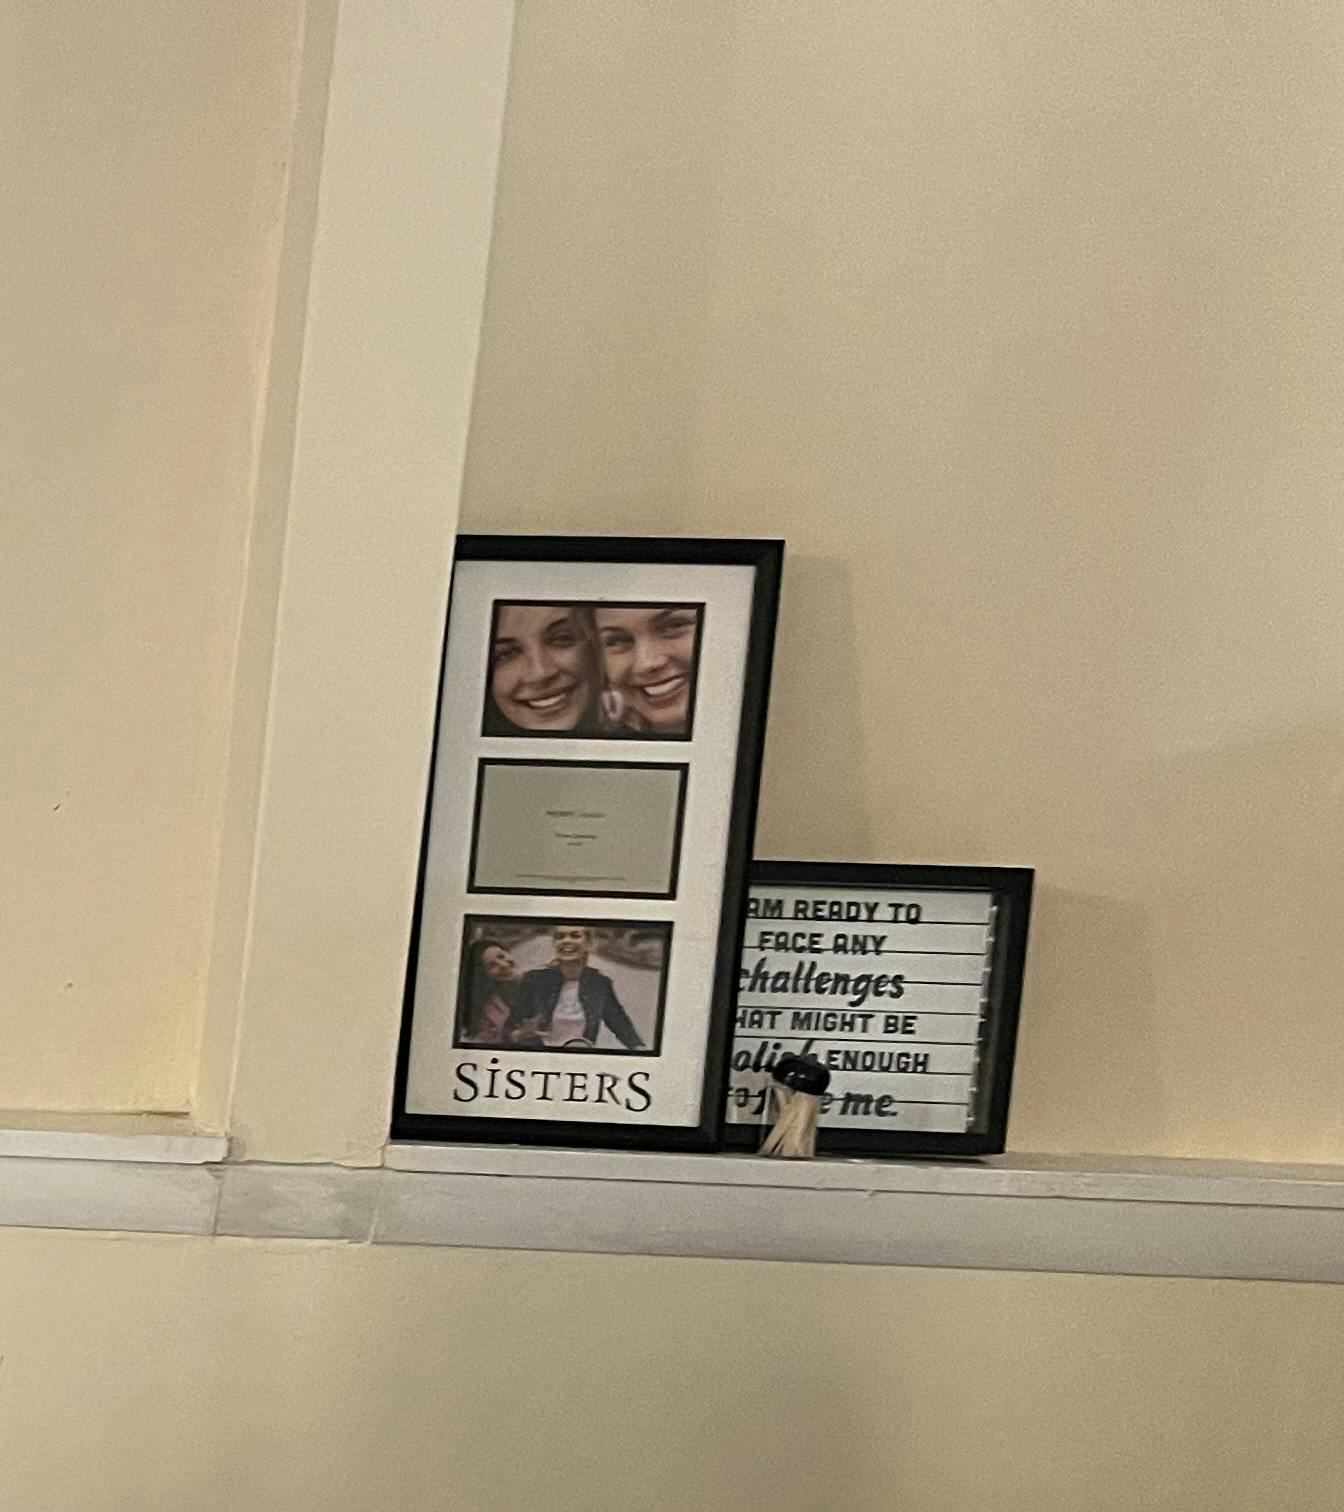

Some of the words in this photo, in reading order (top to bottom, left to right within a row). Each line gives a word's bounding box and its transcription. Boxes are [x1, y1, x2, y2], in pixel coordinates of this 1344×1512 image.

[747, 899, 784, 919] AM
[794, 900, 880, 921] READY
[888, 903, 921, 923] TO
[759, 931, 824, 953] FACE
[833, 933, 887, 955] ANY
[735, 1011, 782, 1029] HAT
[791, 1011, 874, 1033] MIGHT
[883, 1015, 918, 1034] BE
[826, 1049, 930, 1072] ENOUGH
[839, 1091, 897, 1117] me
